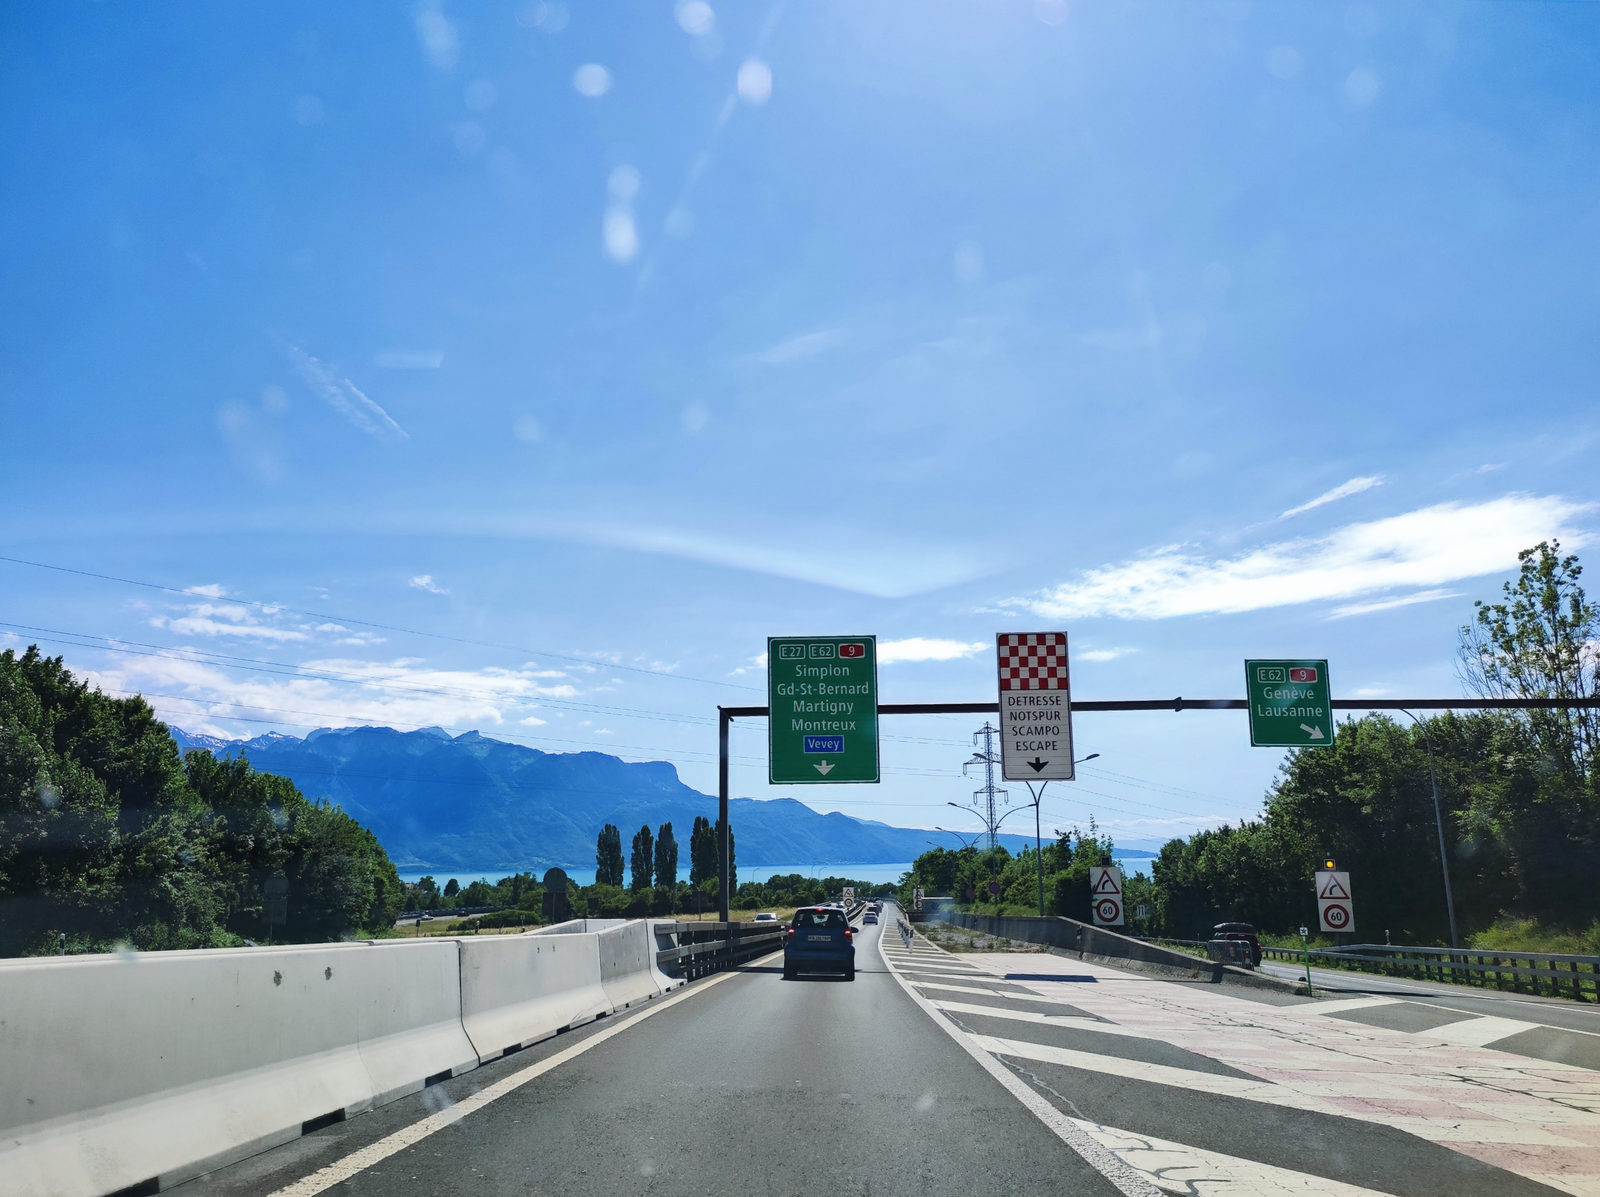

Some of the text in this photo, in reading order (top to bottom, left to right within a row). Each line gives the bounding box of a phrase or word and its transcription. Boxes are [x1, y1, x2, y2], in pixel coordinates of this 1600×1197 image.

[848, 646, 855, 656] 9
[795, 664, 850, 679] Simplon
[1300, 670, 1307, 680] 9
[777, 682, 869, 695] Gd-St-Bernard
[1263, 686, 1315, 699] Genève
[1008, 696, 1061, 706] DETRESSE
[793, 700, 854, 715] Martigny
[1258, 704, 1323, 717] Lausanne
[1010, 711, 1061, 721] NOTSPUR
[791, 719, 856, 731] Montreux
[1012, 726, 1060, 736] SCAMPO
[807, 738, 840, 751] Vevey
[1016, 741, 1058, 751] ESCAPE
[1102, 906, 1113, 915] 60
[1331, 912, 1342, 921] 60
